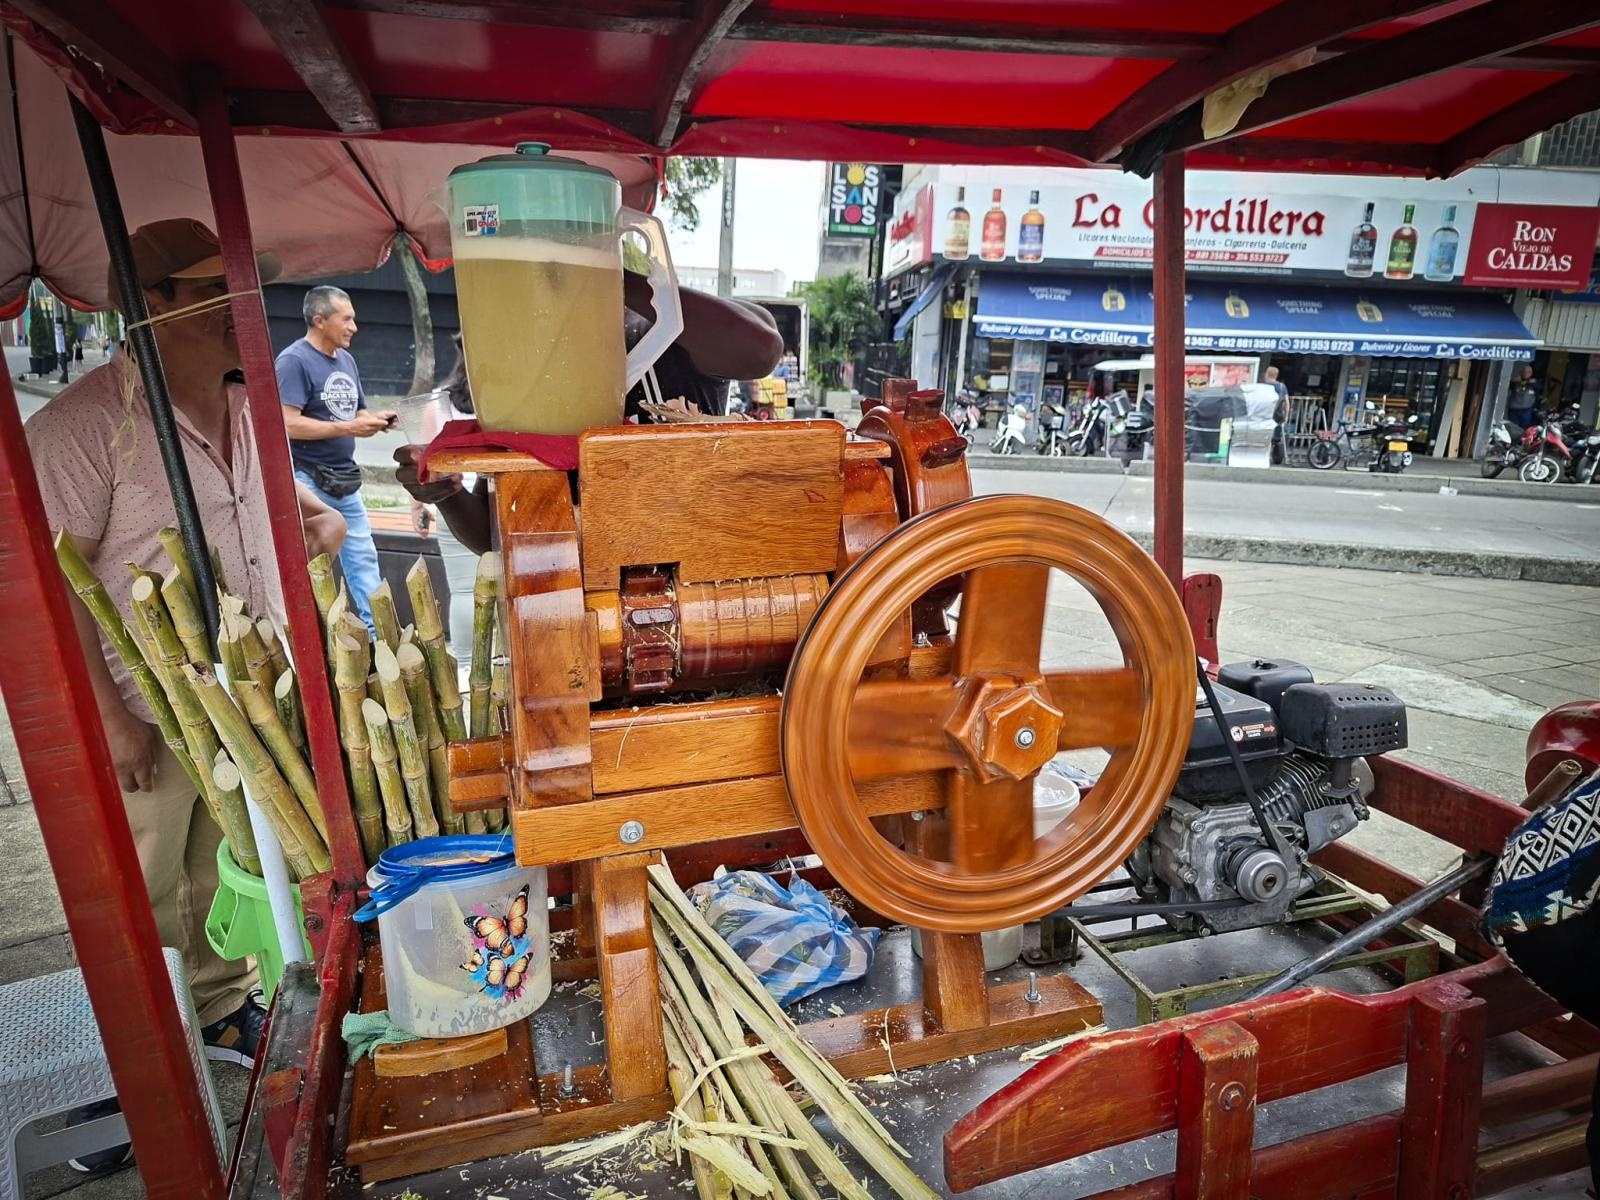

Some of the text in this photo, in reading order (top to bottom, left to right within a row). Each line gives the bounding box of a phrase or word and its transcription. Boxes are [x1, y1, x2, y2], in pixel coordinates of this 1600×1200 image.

[833, 163, 879, 187] LOS
[832, 185, 879, 206] SAN
[832, 204, 876, 225] TOS
[1072, 193, 1121, 228] La
[1112, 234, 1153, 244] Nacionale
[1488, 247, 1572, 272] CALDAS
[1050, 328, 1067, 340] La
[1071, 329, 1138, 344] Cordillera
[1436, 344, 1454, 356] La
[1459, 345, 1531, 359] Cordillera
